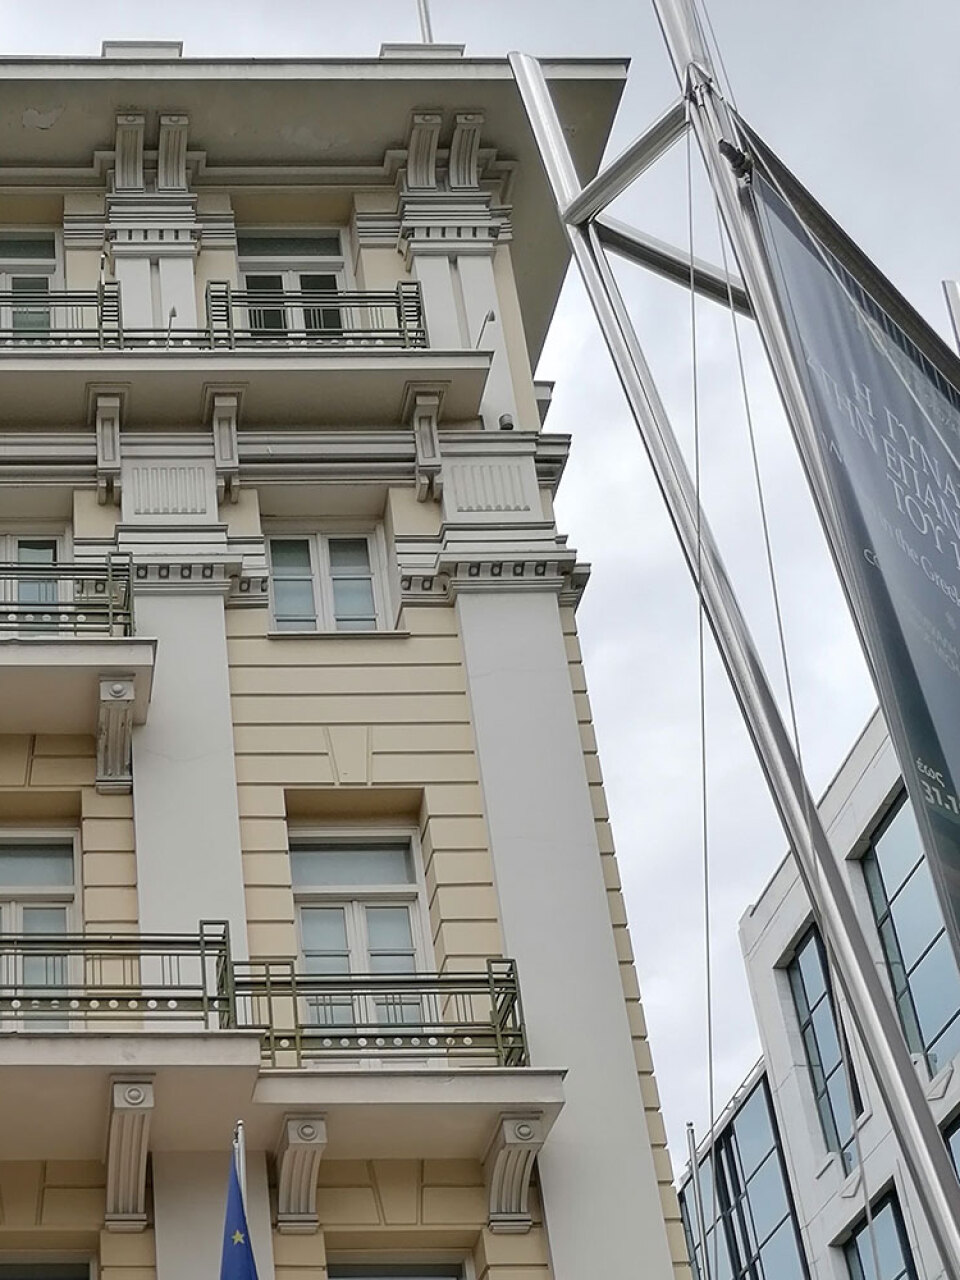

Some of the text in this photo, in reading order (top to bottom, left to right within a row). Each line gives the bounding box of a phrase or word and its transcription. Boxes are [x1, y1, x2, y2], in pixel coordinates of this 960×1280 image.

[807, 356, 878, 454] ΤΗΝ
[883, 406, 960, 509] ΓΥΝΑ
[921, 779, 960, 815] 31.1
